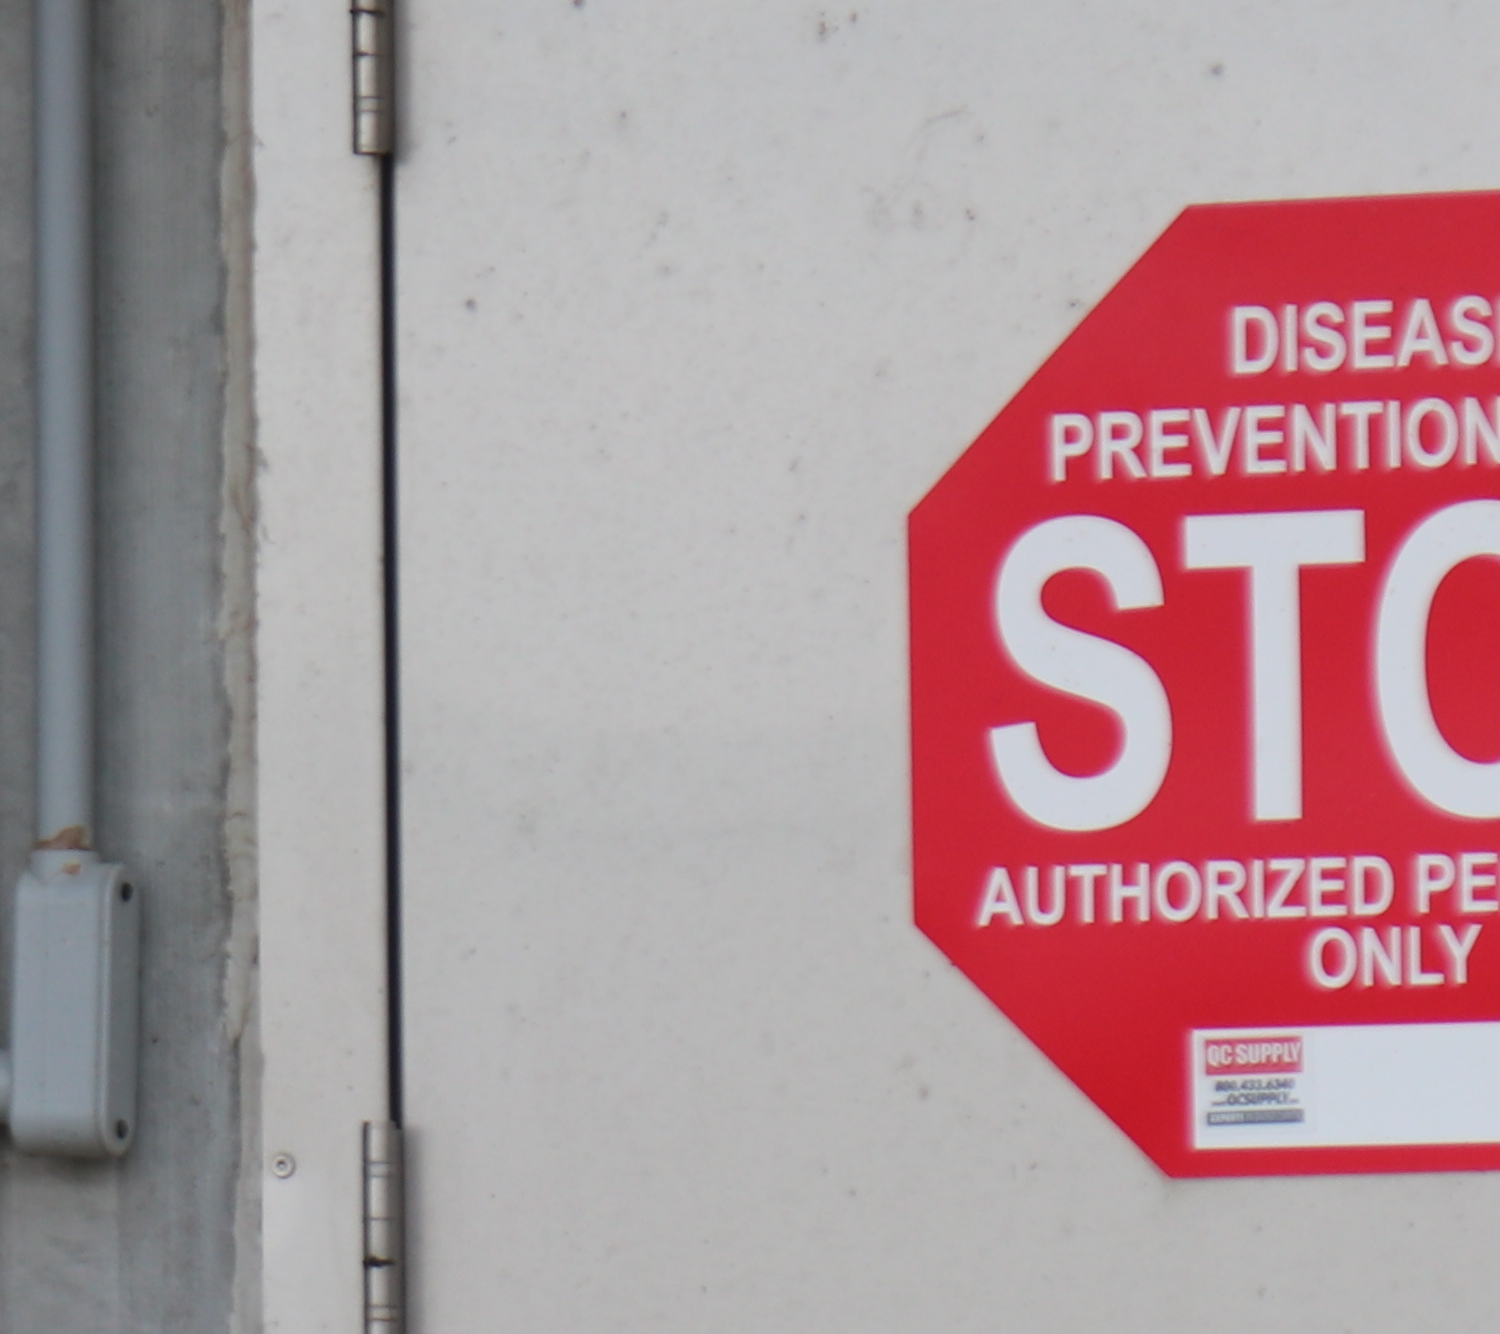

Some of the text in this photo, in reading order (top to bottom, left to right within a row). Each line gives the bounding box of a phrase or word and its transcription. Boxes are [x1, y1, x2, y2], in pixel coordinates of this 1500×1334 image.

[976, 854, 1395, 928] AUTHORIZED
[1306, 923, 1483, 990] ONLY
[1206, 1040, 1302, 1068] QC SUPPLY
